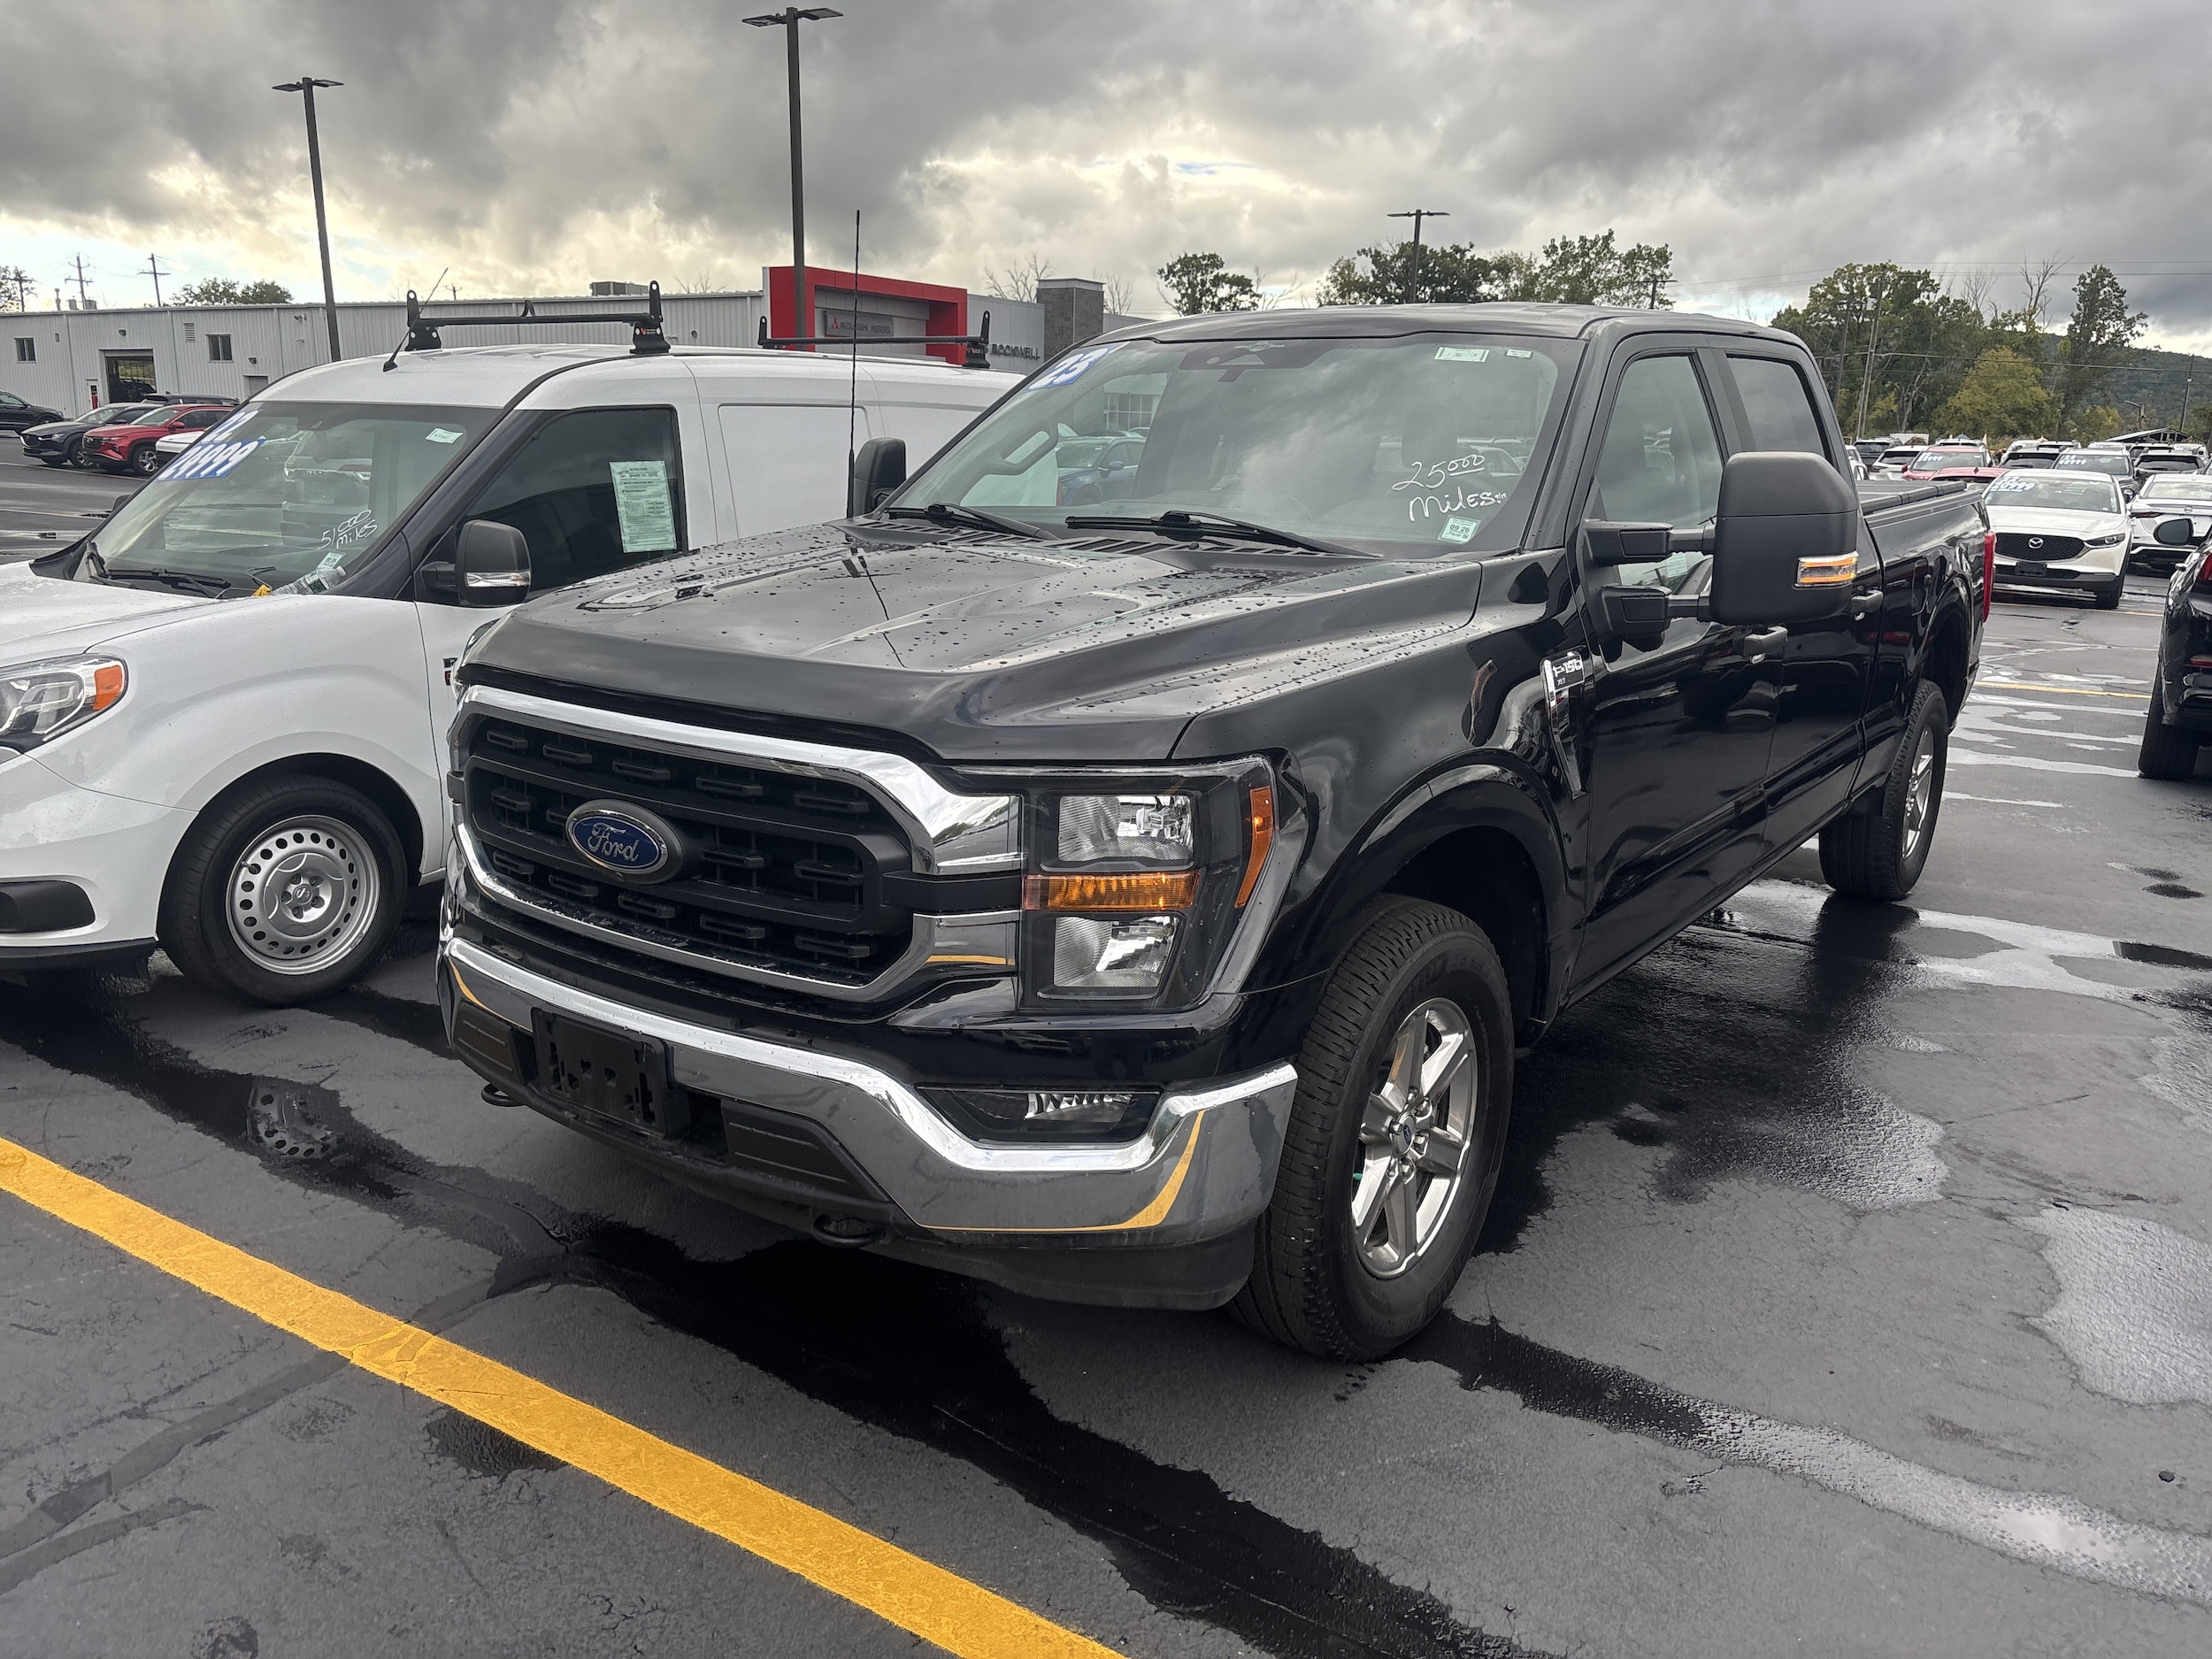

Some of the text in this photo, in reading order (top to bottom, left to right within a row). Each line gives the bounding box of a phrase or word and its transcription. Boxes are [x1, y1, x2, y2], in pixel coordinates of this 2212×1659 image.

[841, 321, 891, 334] MITSBISHI MOTORS
[992, 343, 1041, 359] ROCKWELL
[1029, 348, 1108, 389] 23
[1553, 658, 1582, 678] F-150
[587, 821, 640, 863] Ford
